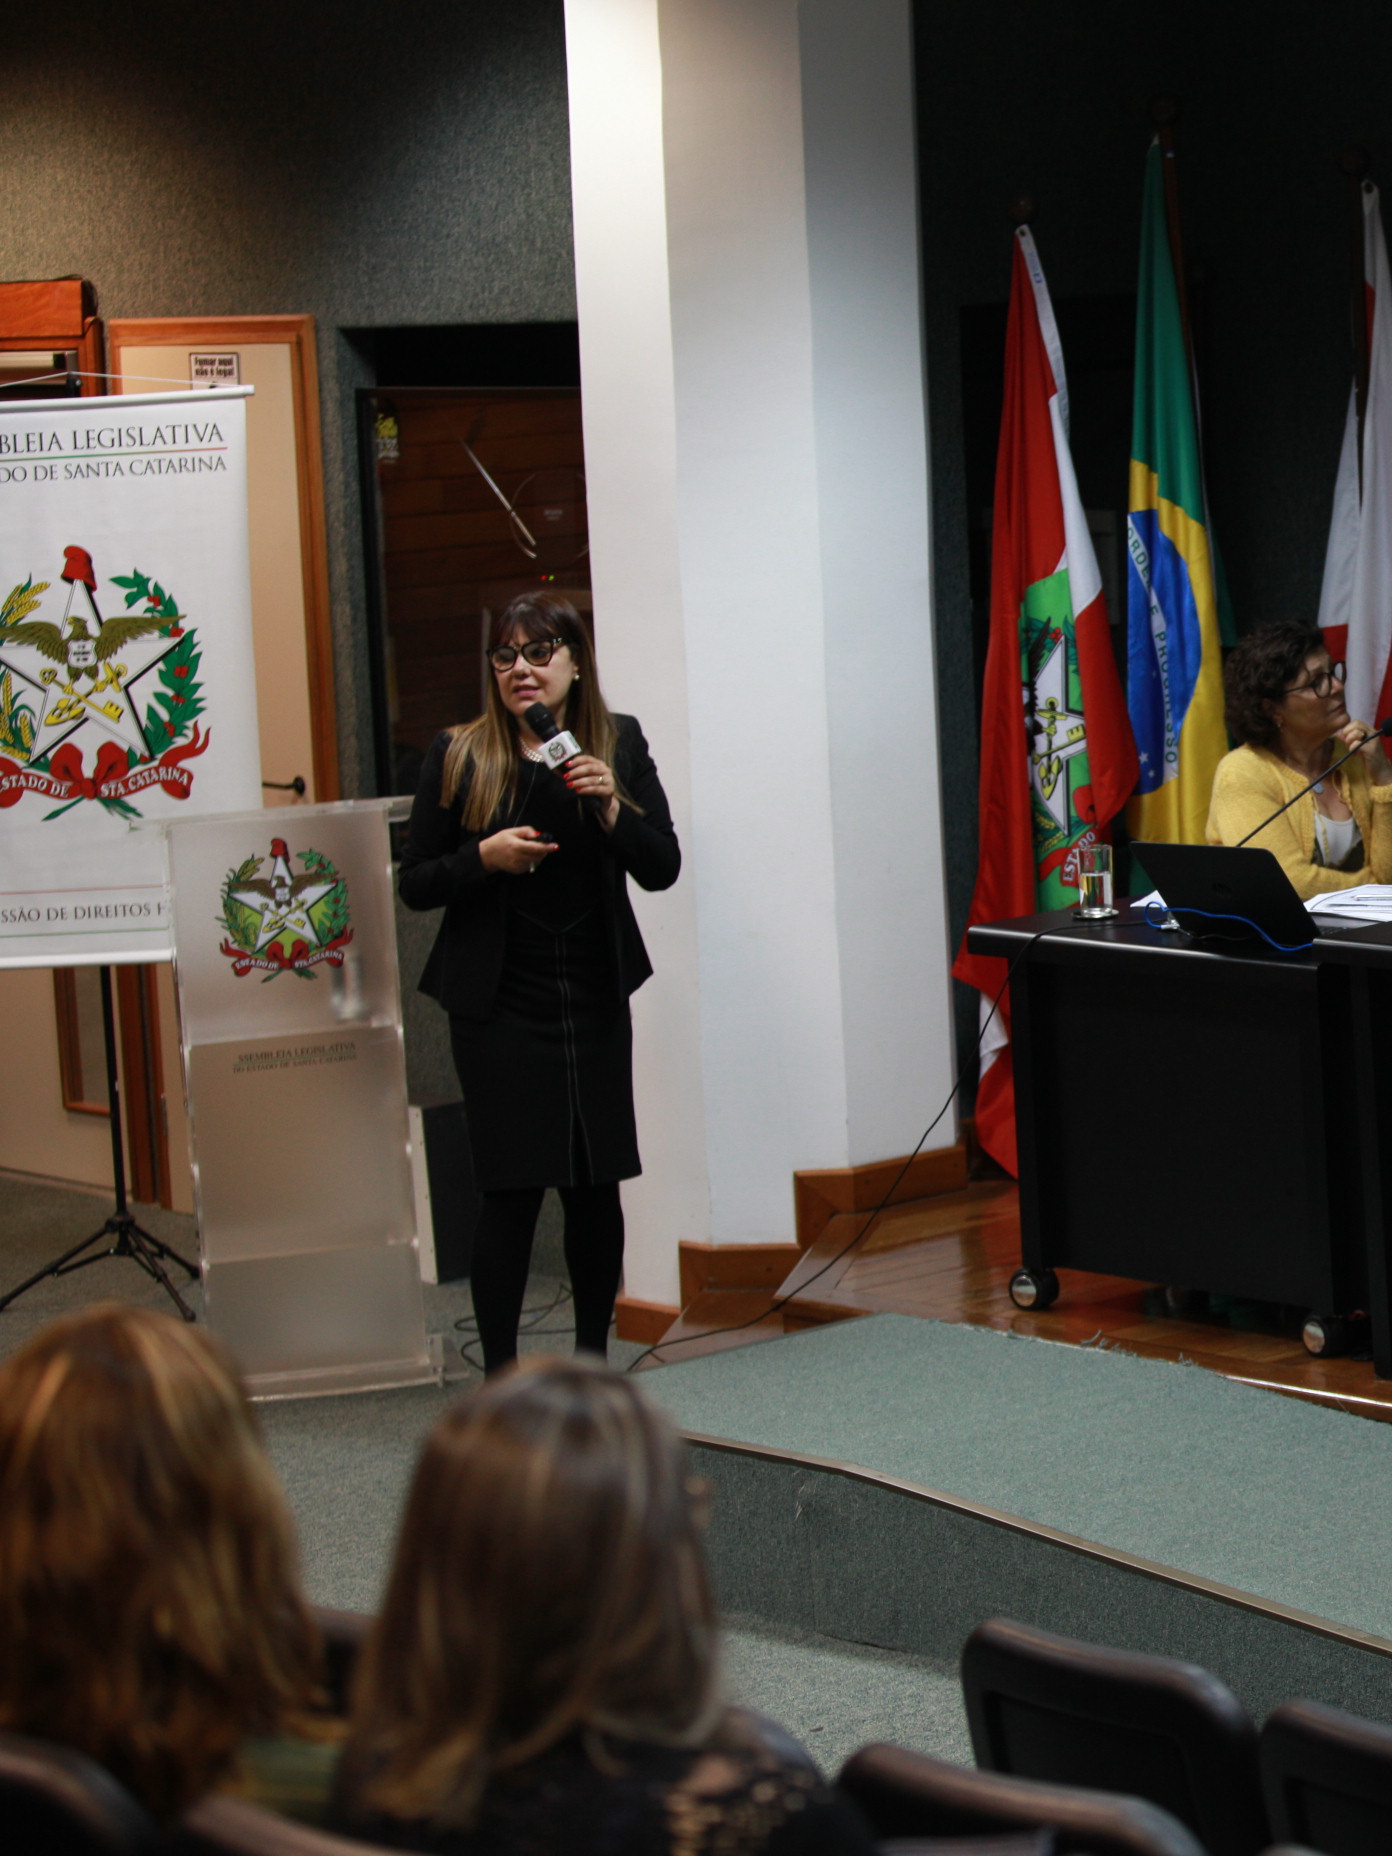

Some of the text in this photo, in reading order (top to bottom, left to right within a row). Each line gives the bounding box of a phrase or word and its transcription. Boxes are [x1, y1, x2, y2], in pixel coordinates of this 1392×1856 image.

[72, 422, 225, 450] LEGISLATIVA
[33, 463, 59, 481] DE
[64, 460, 124, 480] SANTA
[129, 455, 227, 476] CATARINA
[1150, 604, 1159, 616] E
[50, 780, 70, 798] DE
[46, 907, 68, 921] DE
[74, 903, 151, 920] DIREITOS
